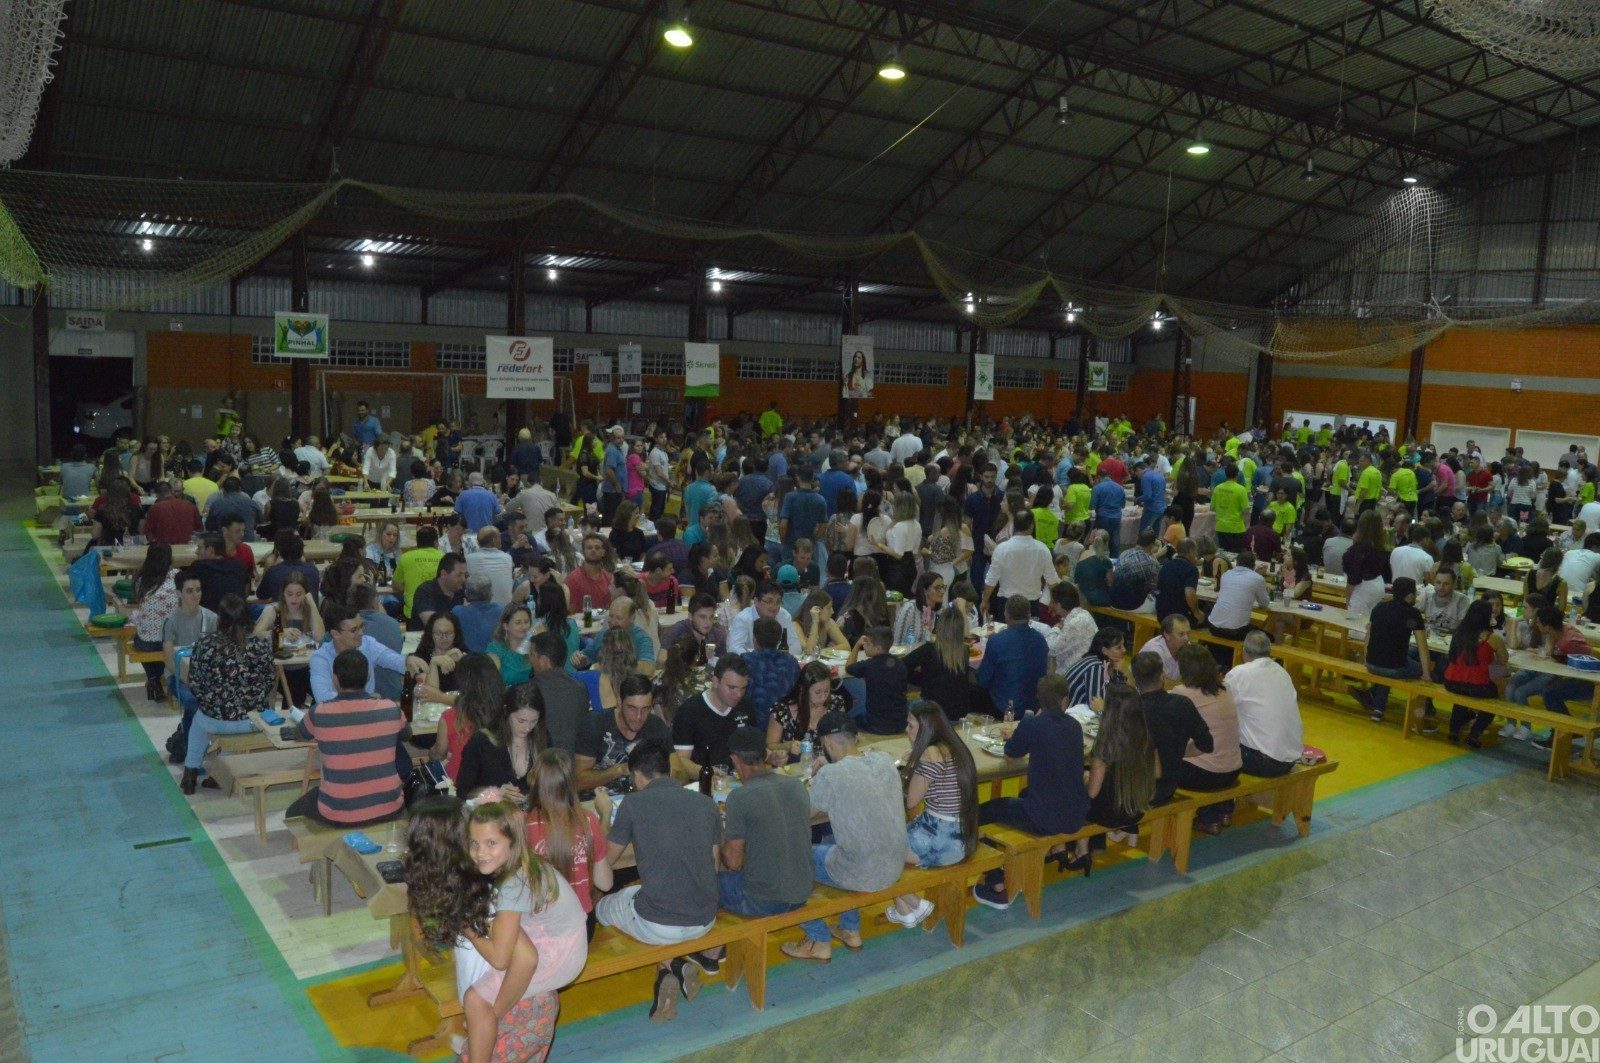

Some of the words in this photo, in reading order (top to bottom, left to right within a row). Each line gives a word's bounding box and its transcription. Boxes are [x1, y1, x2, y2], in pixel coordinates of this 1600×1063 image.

[576, 352, 598, 361] SAI
[497, 364, 543, 373] redefort
[695, 361, 717, 369] Sicredi
